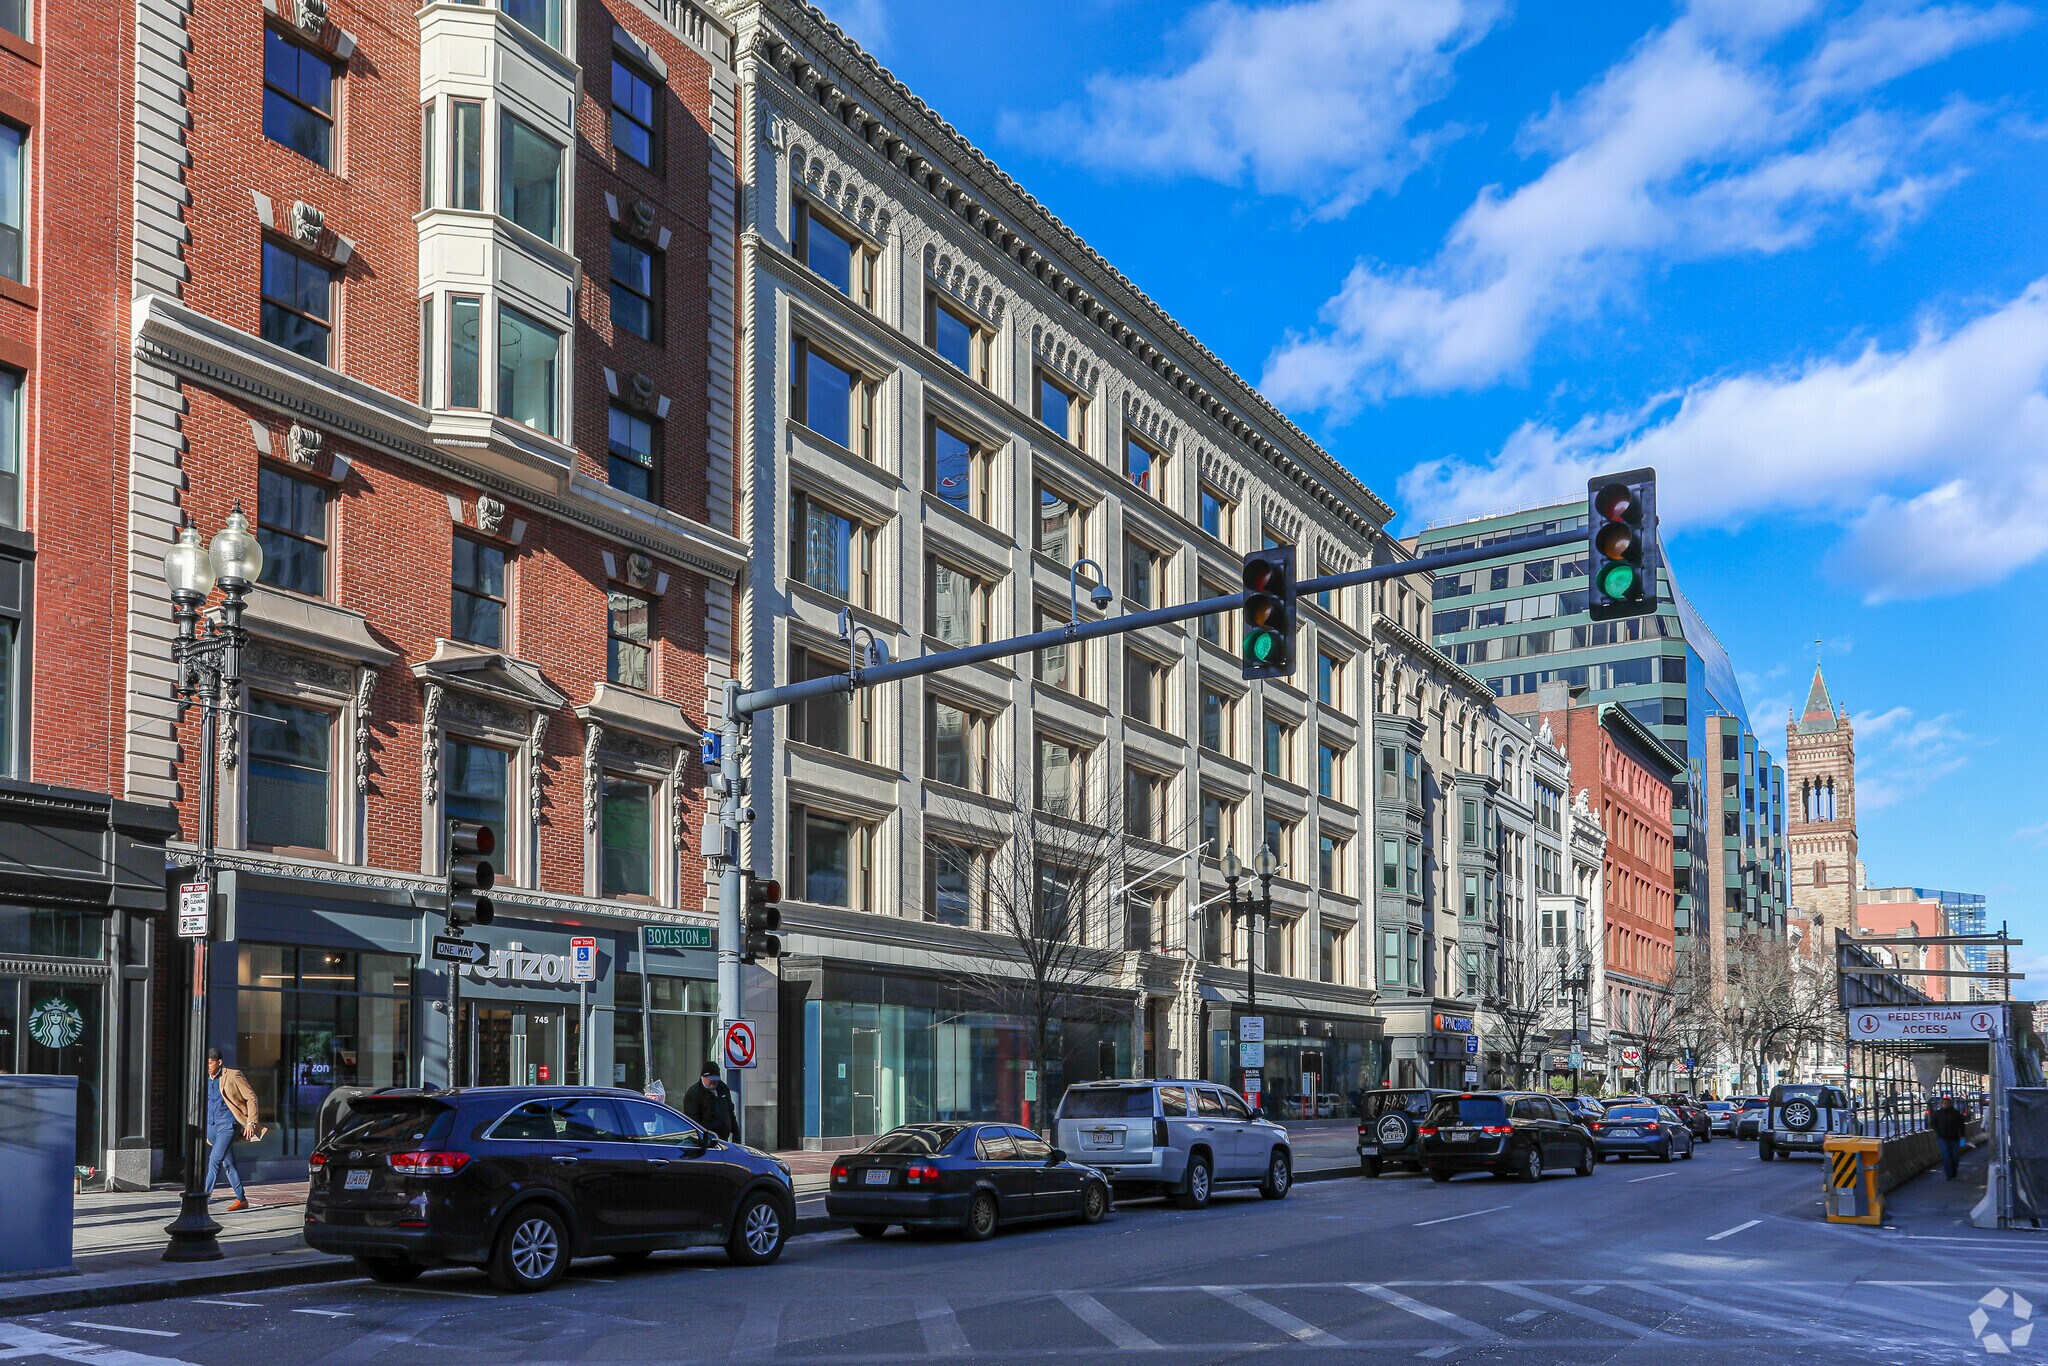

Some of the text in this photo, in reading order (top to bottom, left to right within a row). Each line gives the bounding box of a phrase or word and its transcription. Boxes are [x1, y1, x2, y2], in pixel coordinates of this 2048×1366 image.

[647, 928, 708, 944] BOYLSTON ST
[439, 944, 473, 957] ONE WAY
[534, 1015, 549, 1024] 745
[1888, 1011, 1962, 1022] PEDESTRIAN
[1902, 1025, 1948, 1034] ACCESS
